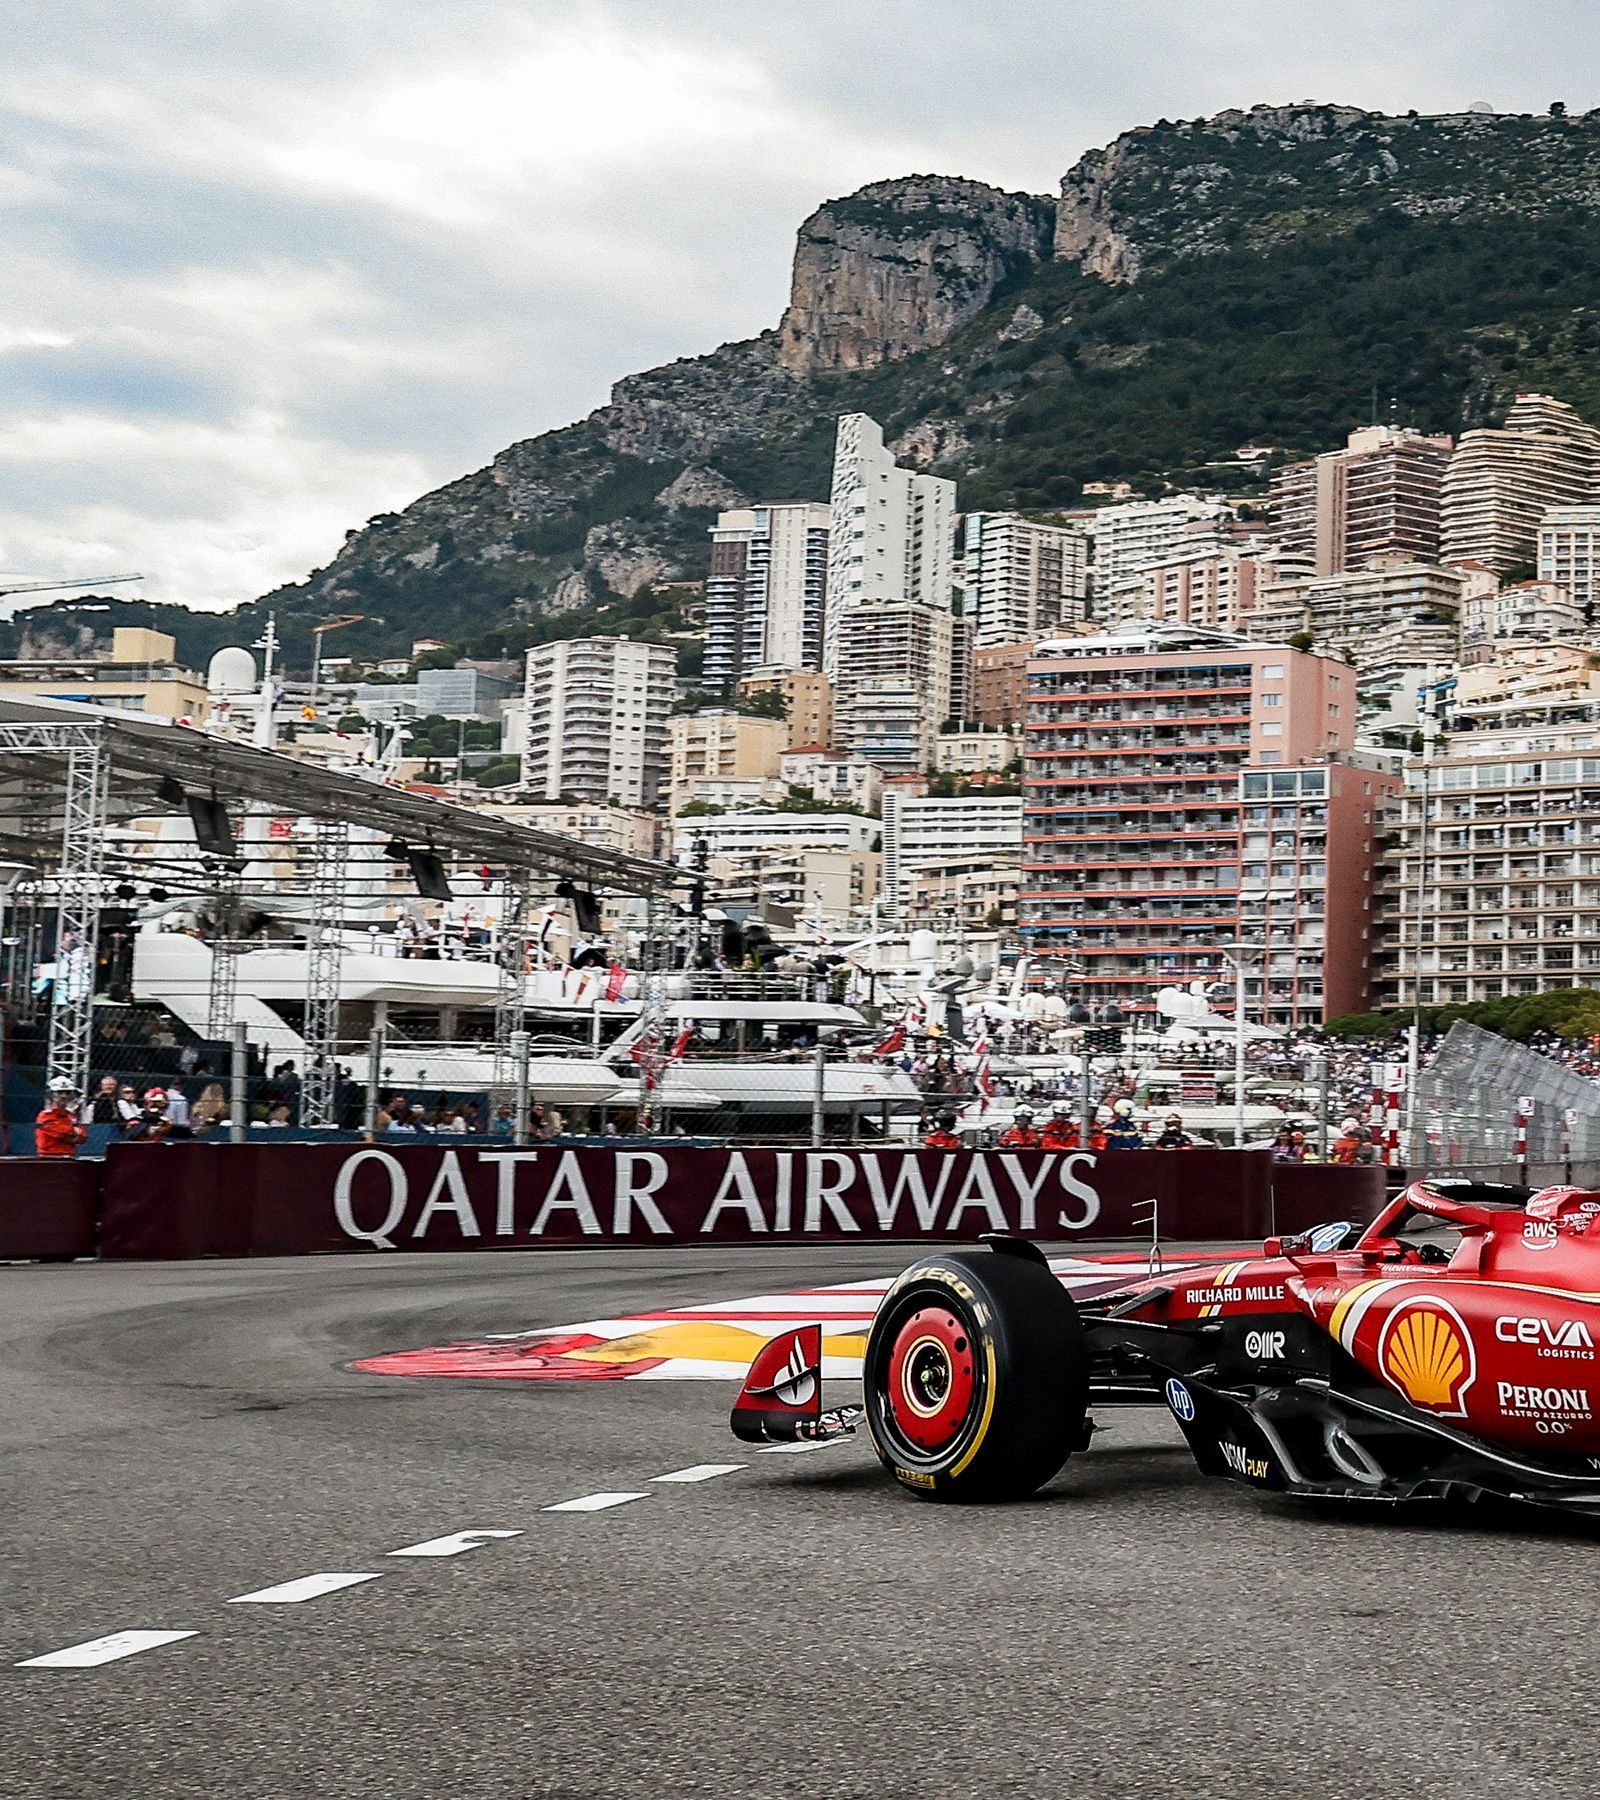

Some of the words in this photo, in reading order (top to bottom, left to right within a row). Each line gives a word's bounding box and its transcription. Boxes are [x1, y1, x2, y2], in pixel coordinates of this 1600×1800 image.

[334, 1149, 674, 1249] QATAR
[700, 1151, 1100, 1232] AIRWAYS
[1523, 1221, 1558, 1239] aws
[1186, 1287, 1242, 1303] RICHARD
[1246, 1286, 1285, 1301] MILLE
[1537, 1348, 1595, 1360] LOGISTICS
[1168, 1379, 1193, 1420] hp
[1497, 1382, 1590, 1411] PERONI
[1501, 1409, 1540, 1418] NASTRO
[1543, 1412, 1592, 1420] AZZURRO
